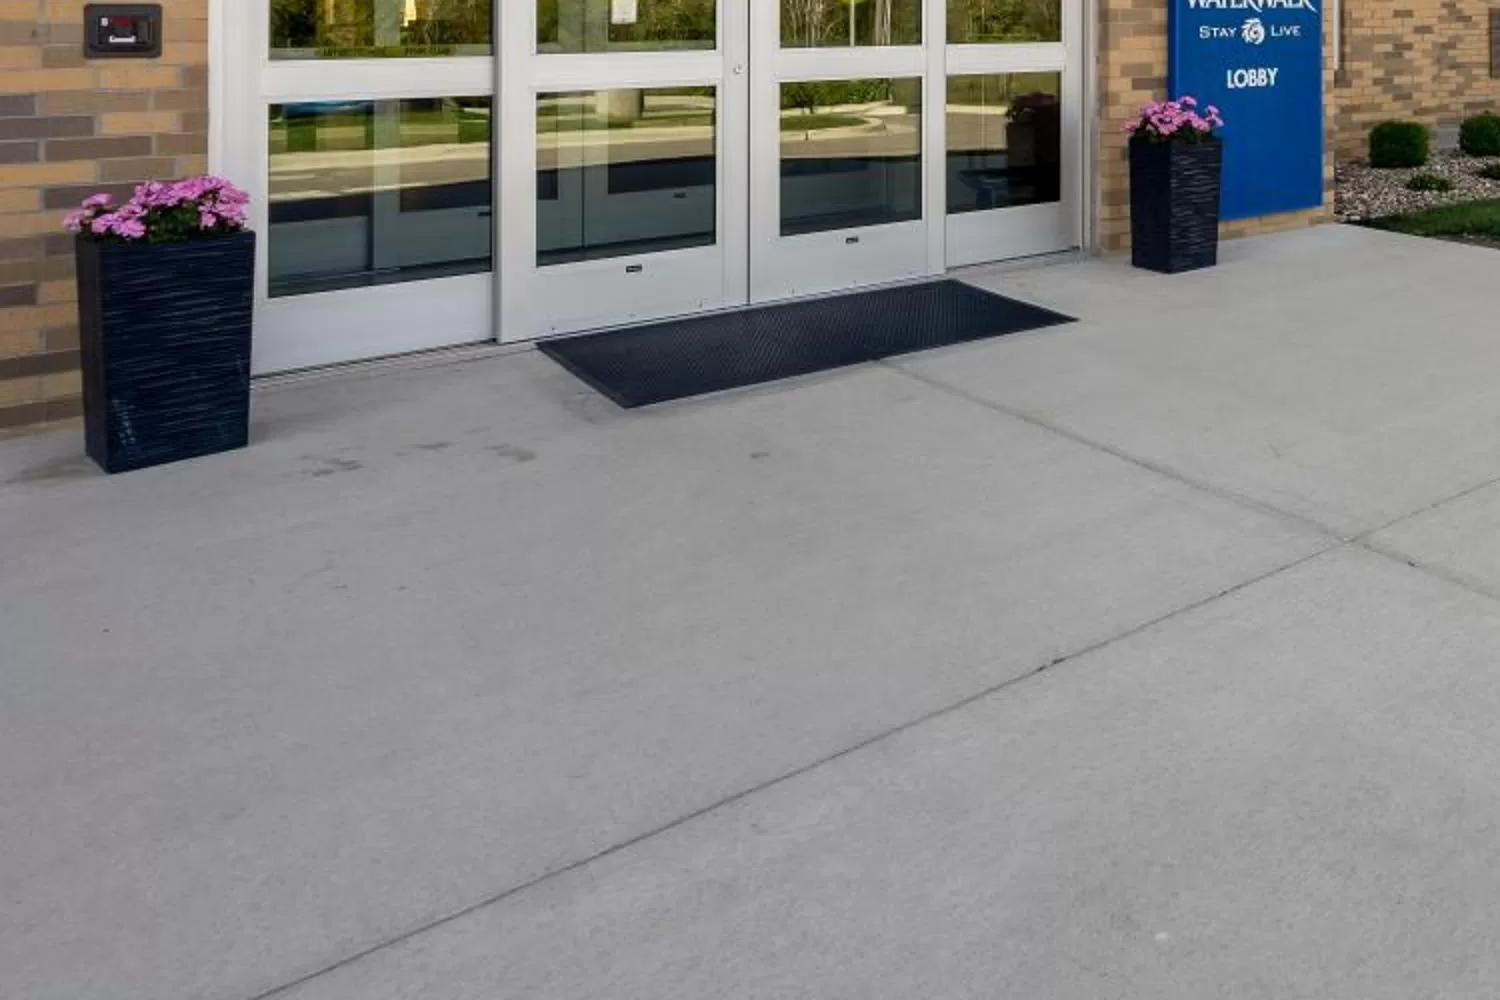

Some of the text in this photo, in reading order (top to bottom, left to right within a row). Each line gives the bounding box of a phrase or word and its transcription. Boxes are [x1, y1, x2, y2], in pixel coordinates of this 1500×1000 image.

[1199, 24, 1301, 39] STAY LIVE
[1226, 67, 1278, 89] LOBBY
